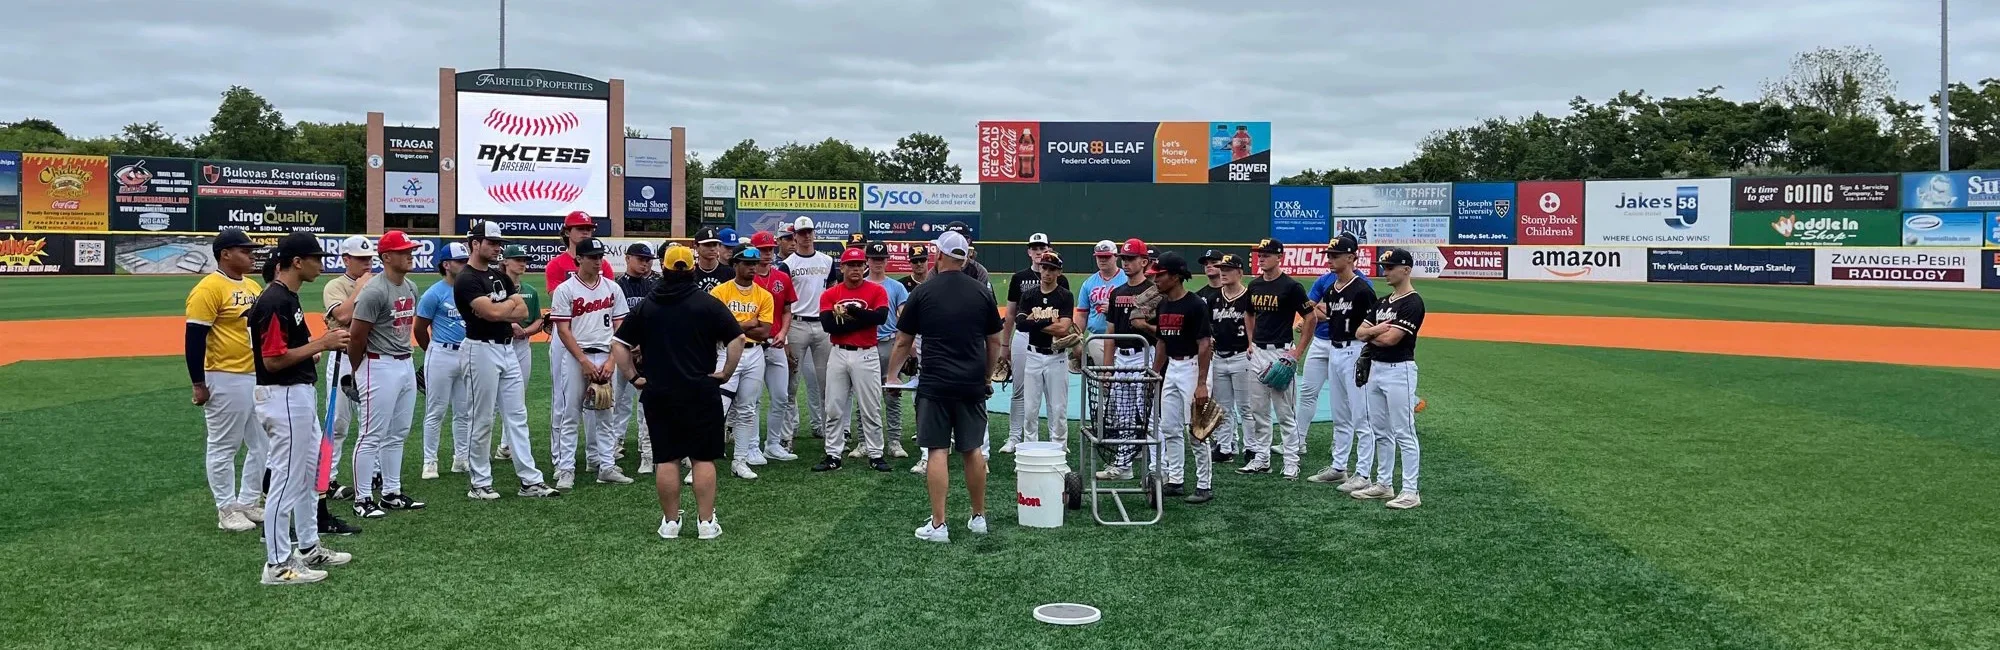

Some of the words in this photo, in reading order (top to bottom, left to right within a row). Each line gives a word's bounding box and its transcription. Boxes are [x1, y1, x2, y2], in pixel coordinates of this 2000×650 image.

[476, 73, 533, 87] FAIRFIELD
[536, 79, 593, 91] PROPERTIES
[982, 127, 990, 143] AN
[390, 139, 433, 149] TRAGAR
[991, 127, 999, 156] COLD
[1048, 141, 1088, 153] FOUR
[1105, 141, 1144, 154] LEAF
[1162, 149, 1188, 157] Money
[477, 143, 590, 172] AXCESS
[982, 146, 990, 176] GRAB
[1162, 157, 1198, 165] Together
[445, 161, 450, 169] 4
[500, 161, 536, 172] BASEBALL
[991, 158, 999, 177] ICE
[1229, 163, 1267, 173] POWER
[222, 166, 267, 178] Bulovas
[271, 168, 336, 180] Restorations
[613, 167, 621, 175] 16
[1229, 172, 1250, 181] ADE
[1968, 176, 2000, 190] Su
[740, 184, 768, 199] RAY
[788, 185, 857, 200] PLUMBER
[1404, 187, 1447, 198] TRAFFIC
[1744, 186, 1756, 194] It's
[1758, 186, 1779, 194] time
[1784, 184, 1834, 204] GOING
[628, 200, 648, 208] Island
[649, 200, 668, 208] Shore
[1615, 192, 1673, 209] Jake's
[1678, 197, 1697, 209] 58
[1758, 194, 1774, 203] get
[1274, 200, 1301, 209] DDK&
[1274, 209, 1320, 219] COMPANY
[1458, 208, 1493, 216] University
[816, 221, 849, 229] Alliance
[869, 220, 891, 230] Nice
[892, 221, 916, 230] save!
[1521, 215, 1548, 226] Stony
[1549, 215, 1578, 224] Brook
[1842, 218, 1859, 230] In
[498, 222, 536, 231] OFSTRA
[1525, 227, 1574, 236] Children's
[730, 233, 737, 241] D
[1801, 231, 1847, 242] Shop
[0, 239, 47, 256] ANG!
[530, 245, 566, 253] MEDIC
[1283, 248, 1329, 266] RICHA
[1454, 257, 1502, 268] ONLINE
[1532, 250, 1621, 267] amazon
[1832, 254, 1965, 266] ZWANGER-PESIRI
[1668, 263, 1699, 271] Kyriakos
[1700, 263, 1723, 272] Group
[1734, 264, 1765, 273] Morgan
[1766, 264, 1796, 273] Stanley
[1849, 269, 1947, 280] RADIOLOGY
[572, 293, 615, 318] Beast
[1251, 294, 1279, 307] MAFIA
[603, 314, 610, 327] 8
[1344, 318, 1350, 332] 1
[1237, 325, 1245, 336] 3
